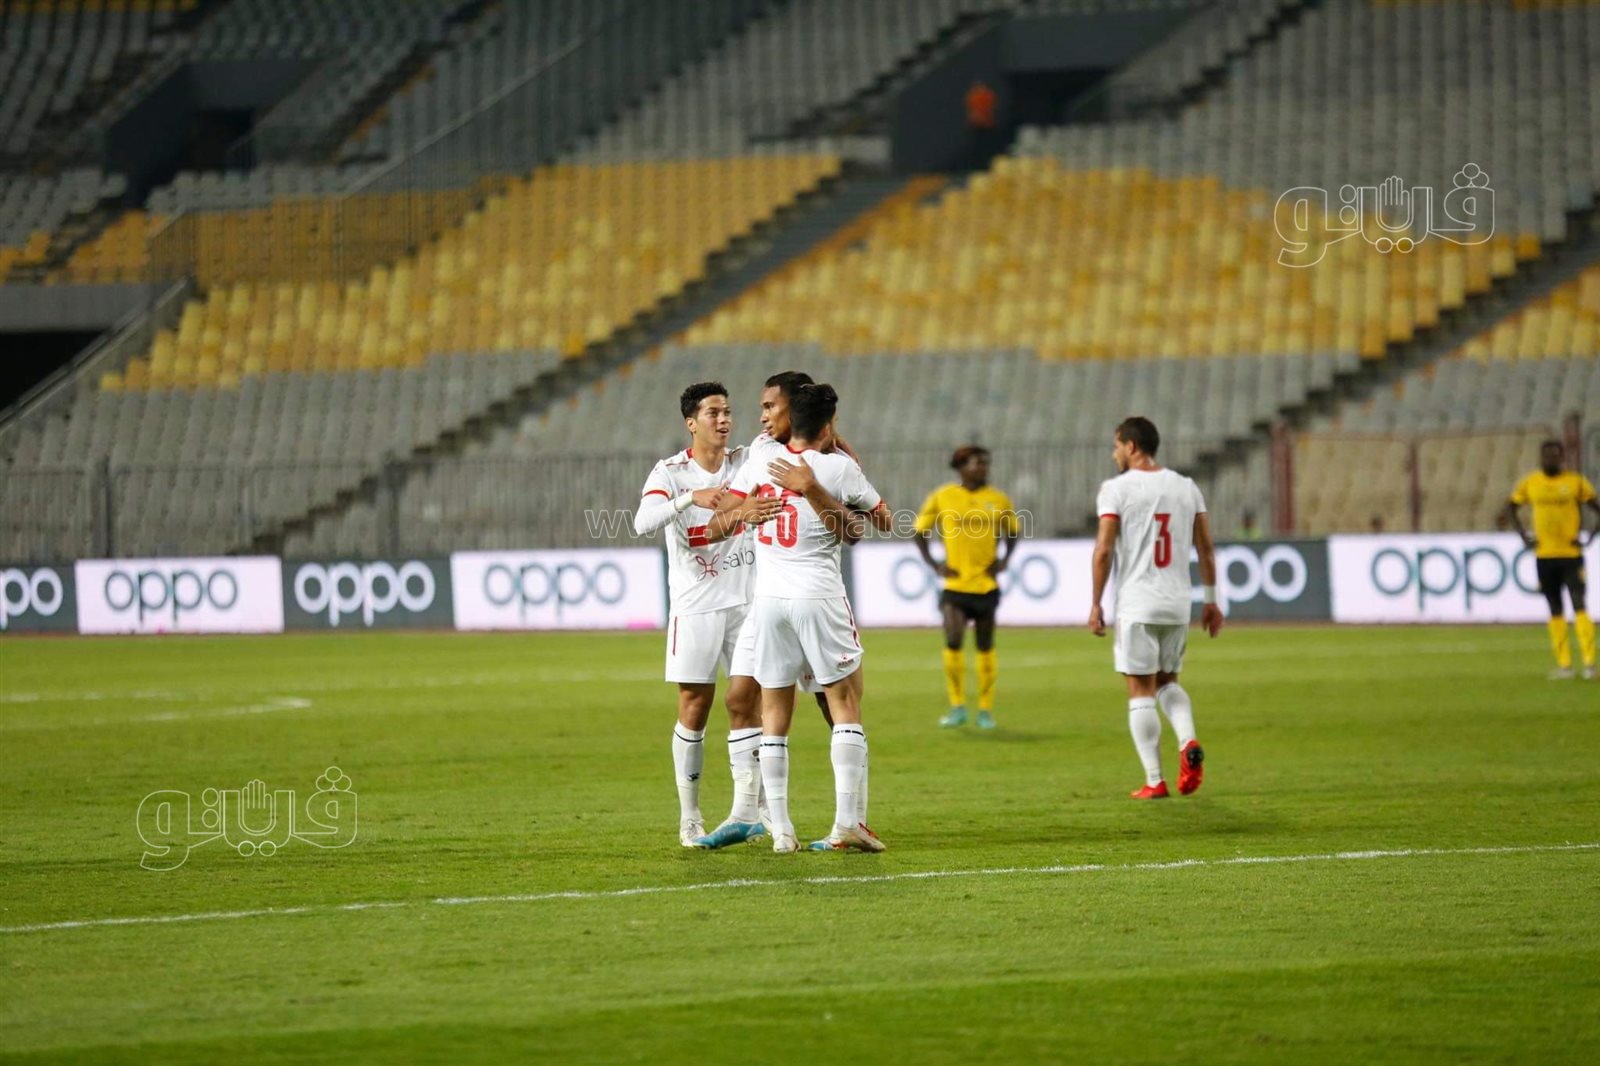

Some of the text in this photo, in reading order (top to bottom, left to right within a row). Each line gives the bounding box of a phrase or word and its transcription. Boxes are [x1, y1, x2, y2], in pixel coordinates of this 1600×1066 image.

[1153, 512, 1173, 569] 3
[104, 568, 238, 623] oppo
[294, 561, 435, 627] oppo
[483, 560, 627, 619] oppo
[891, 554, 1057, 602] oo
